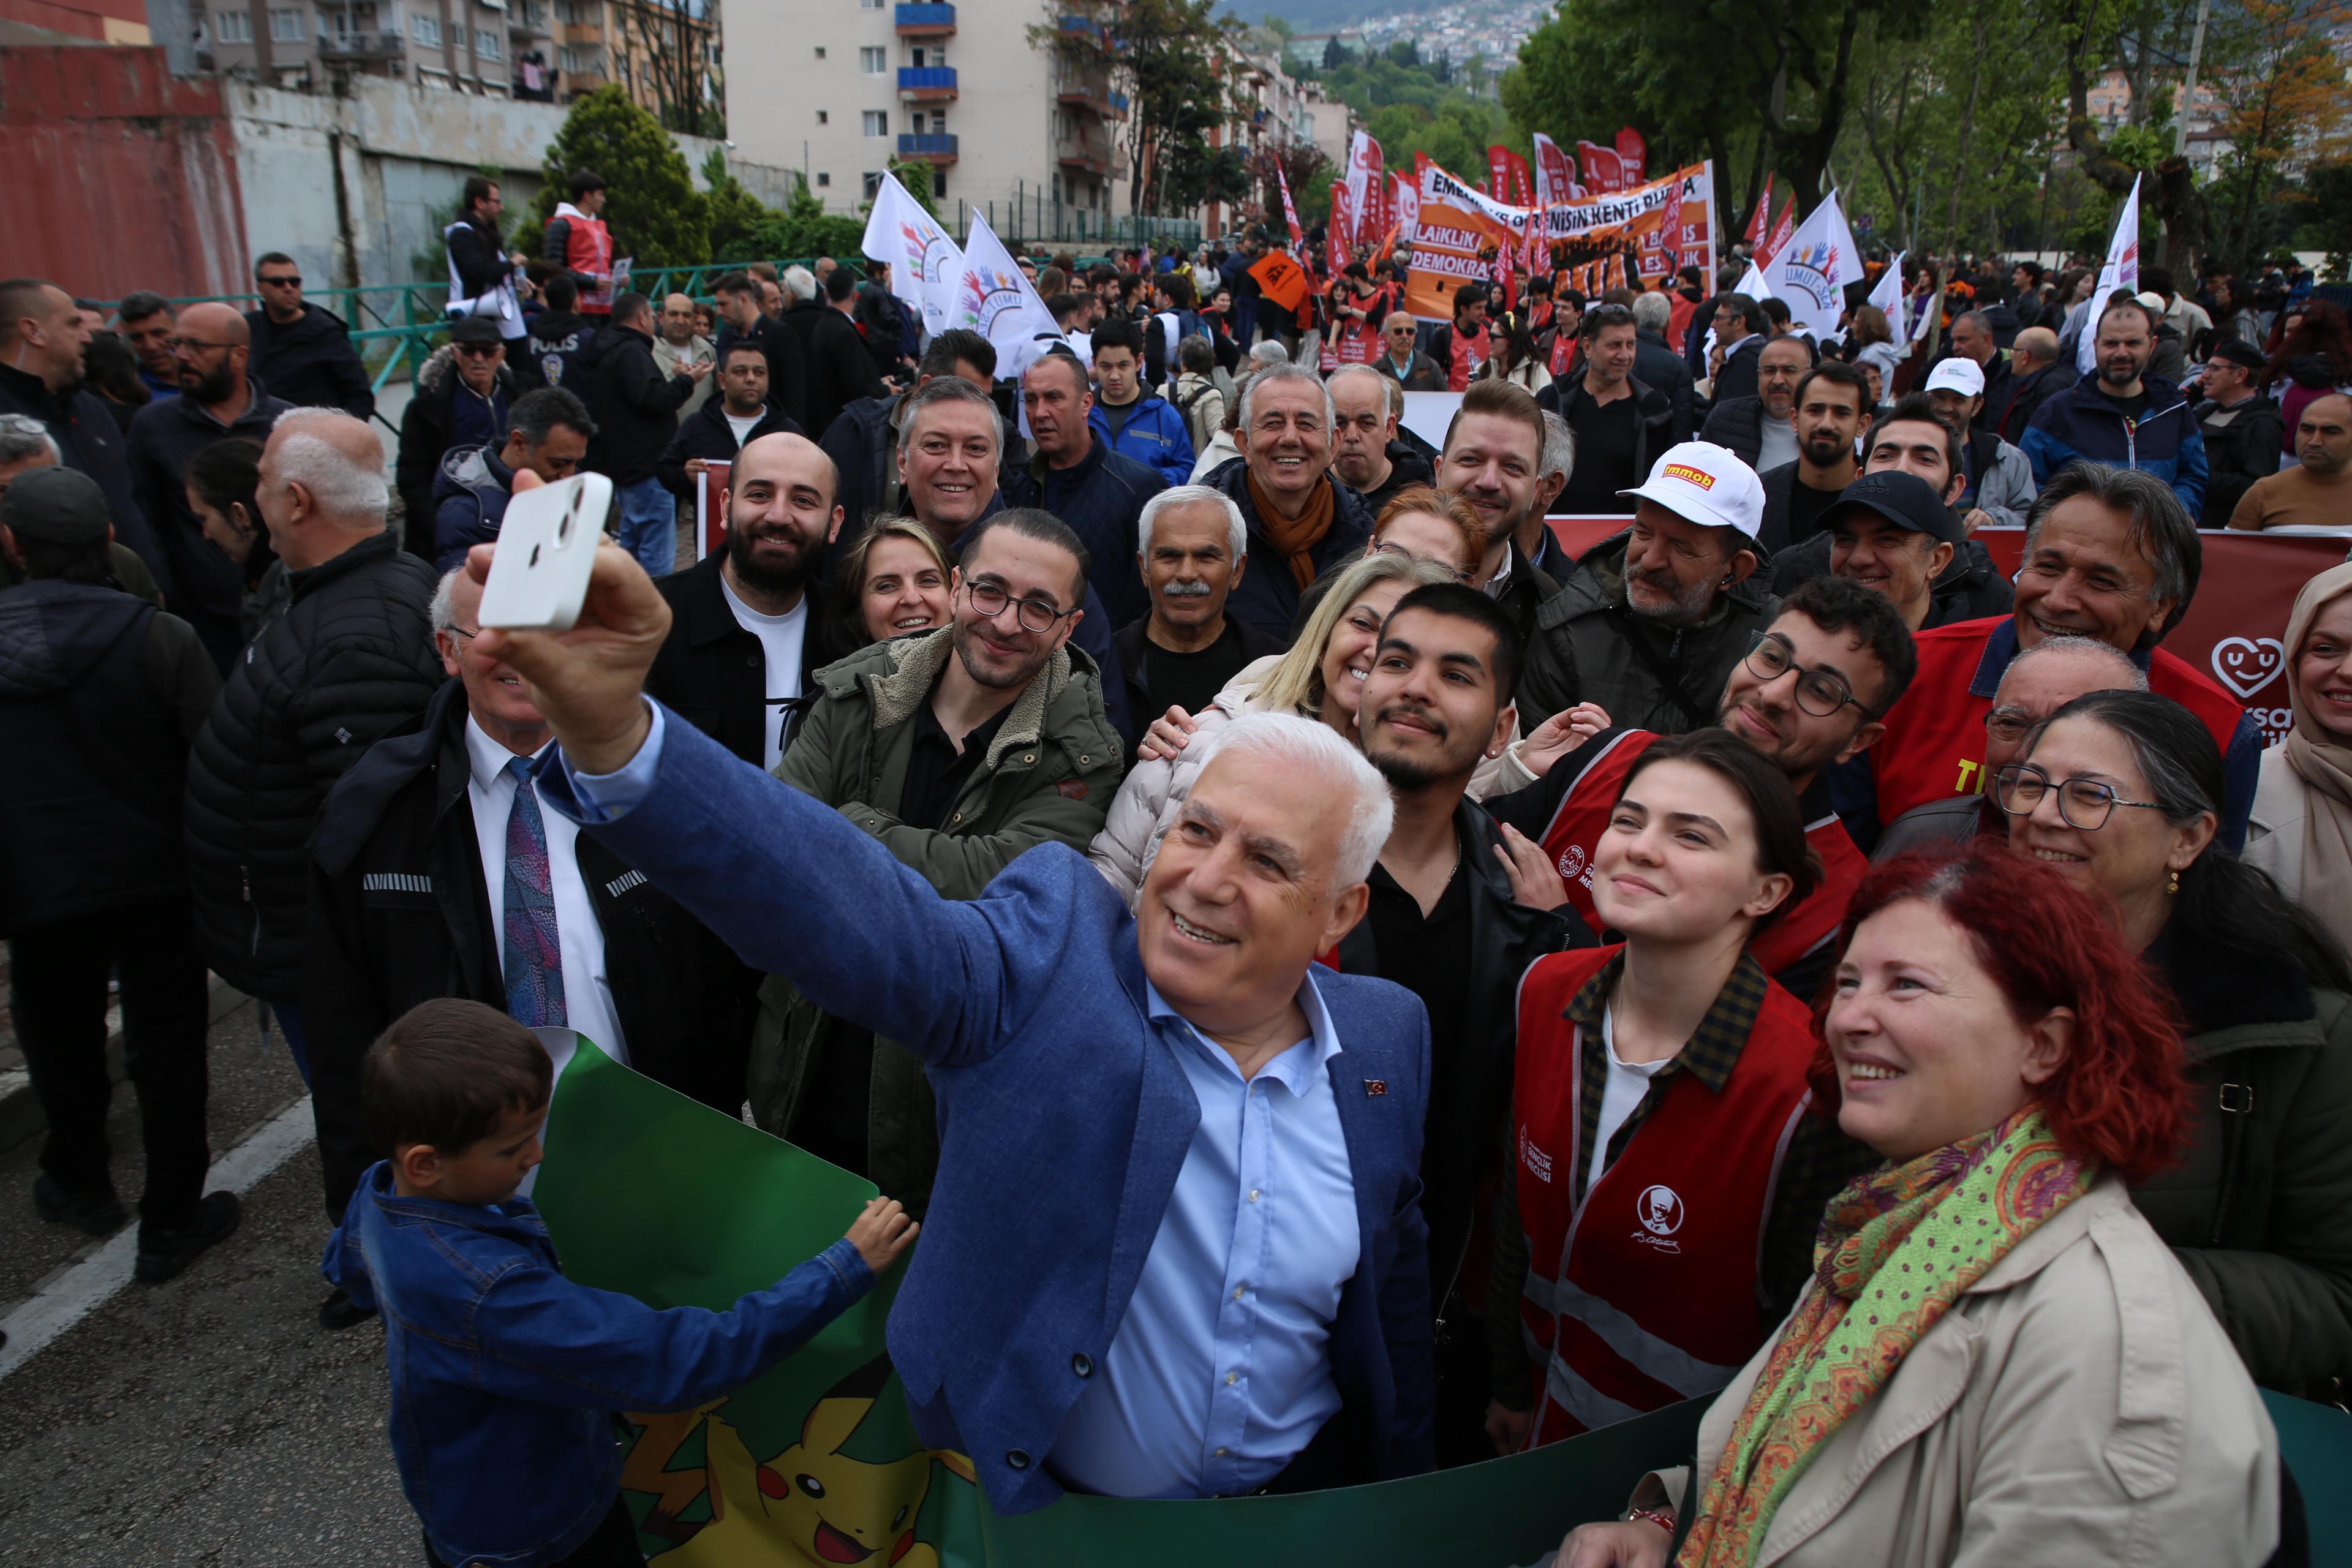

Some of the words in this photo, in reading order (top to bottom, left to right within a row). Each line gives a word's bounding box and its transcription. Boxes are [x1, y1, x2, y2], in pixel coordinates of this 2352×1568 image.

[1785, 268, 1833, 309] UMUT-SEN
[1664, 465, 1712, 486] tmmob
[1852, 485, 1891, 496] adidas
[1572, 847, 1583, 859] BURSA
